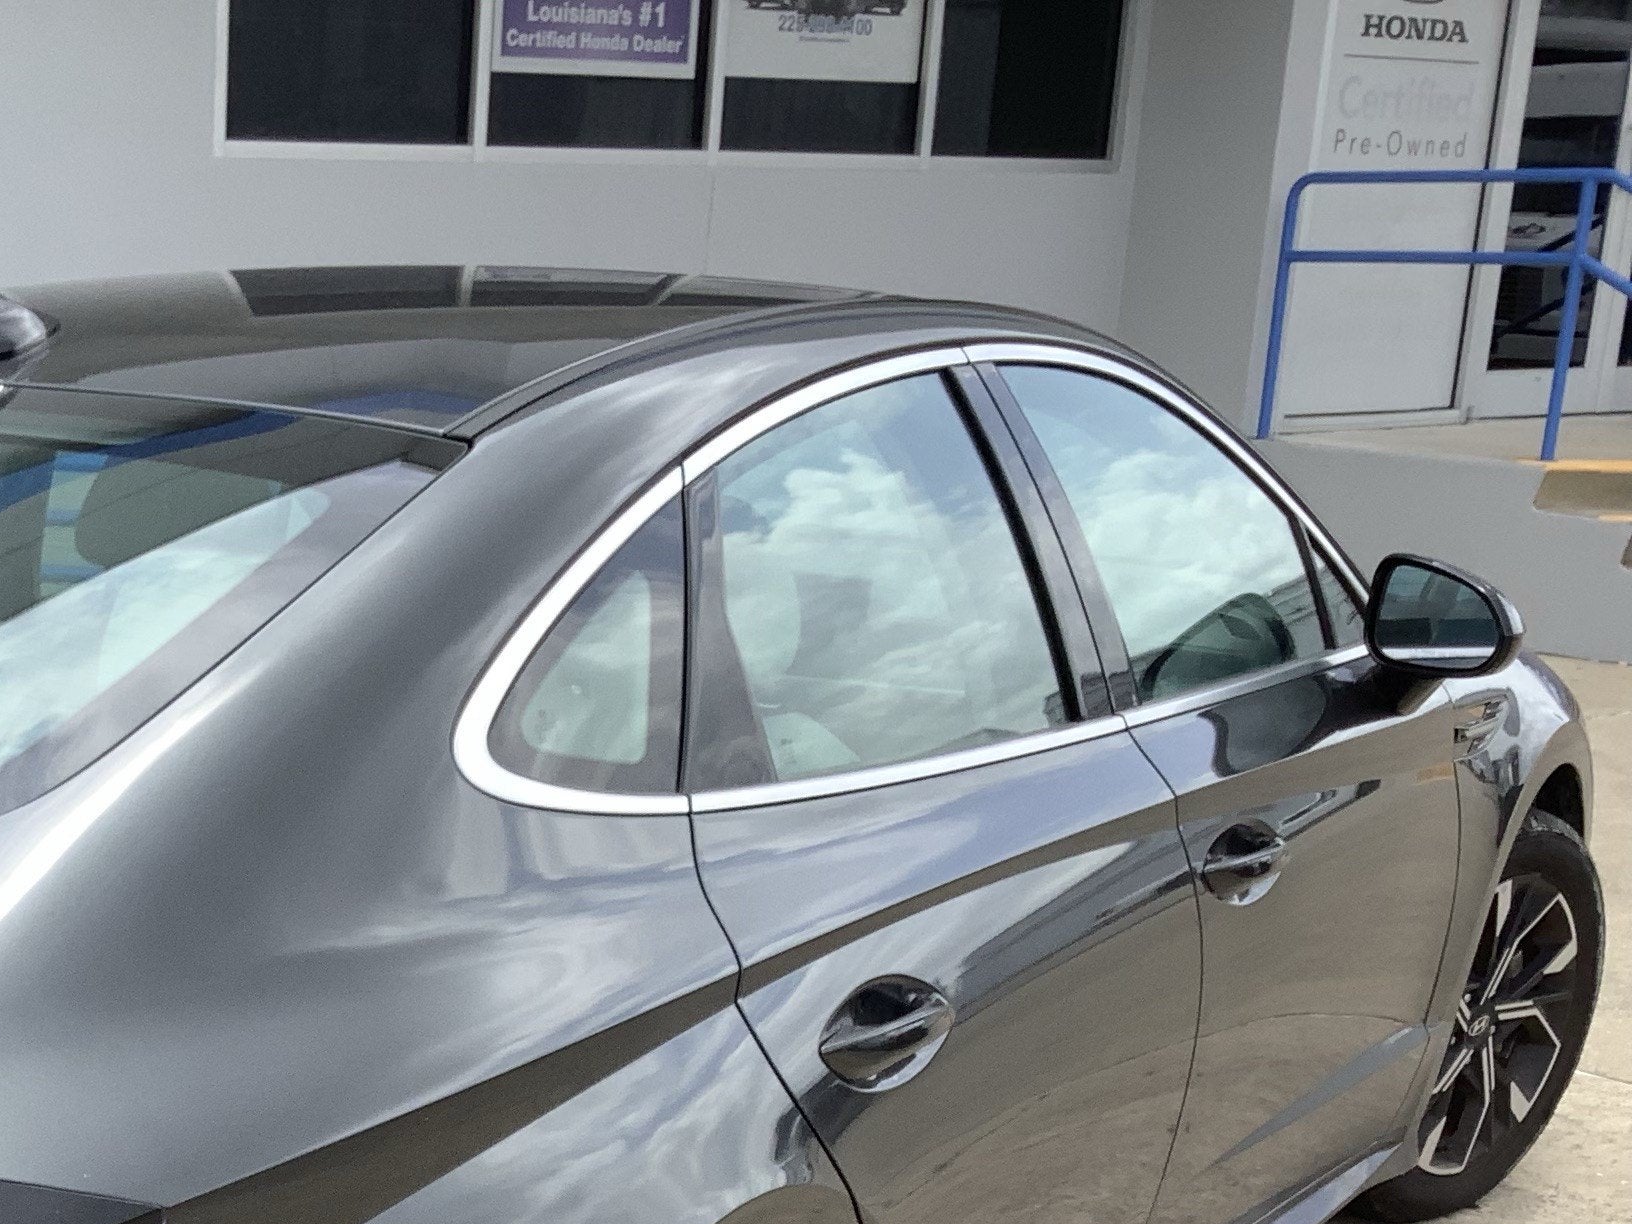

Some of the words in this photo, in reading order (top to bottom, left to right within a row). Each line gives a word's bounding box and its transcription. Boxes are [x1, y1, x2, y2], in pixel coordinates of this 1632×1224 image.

[526, 0, 633, 27] Louisiana's
[639, 1, 667, 28] #1
[1360, 13, 1469, 44] HONDA
[506, 28, 577, 49] Certified
[580, 31, 629, 51] Honda
[633, 34, 683, 54] Dealer
[1333, 128, 1469, 158] Pre-Owned
